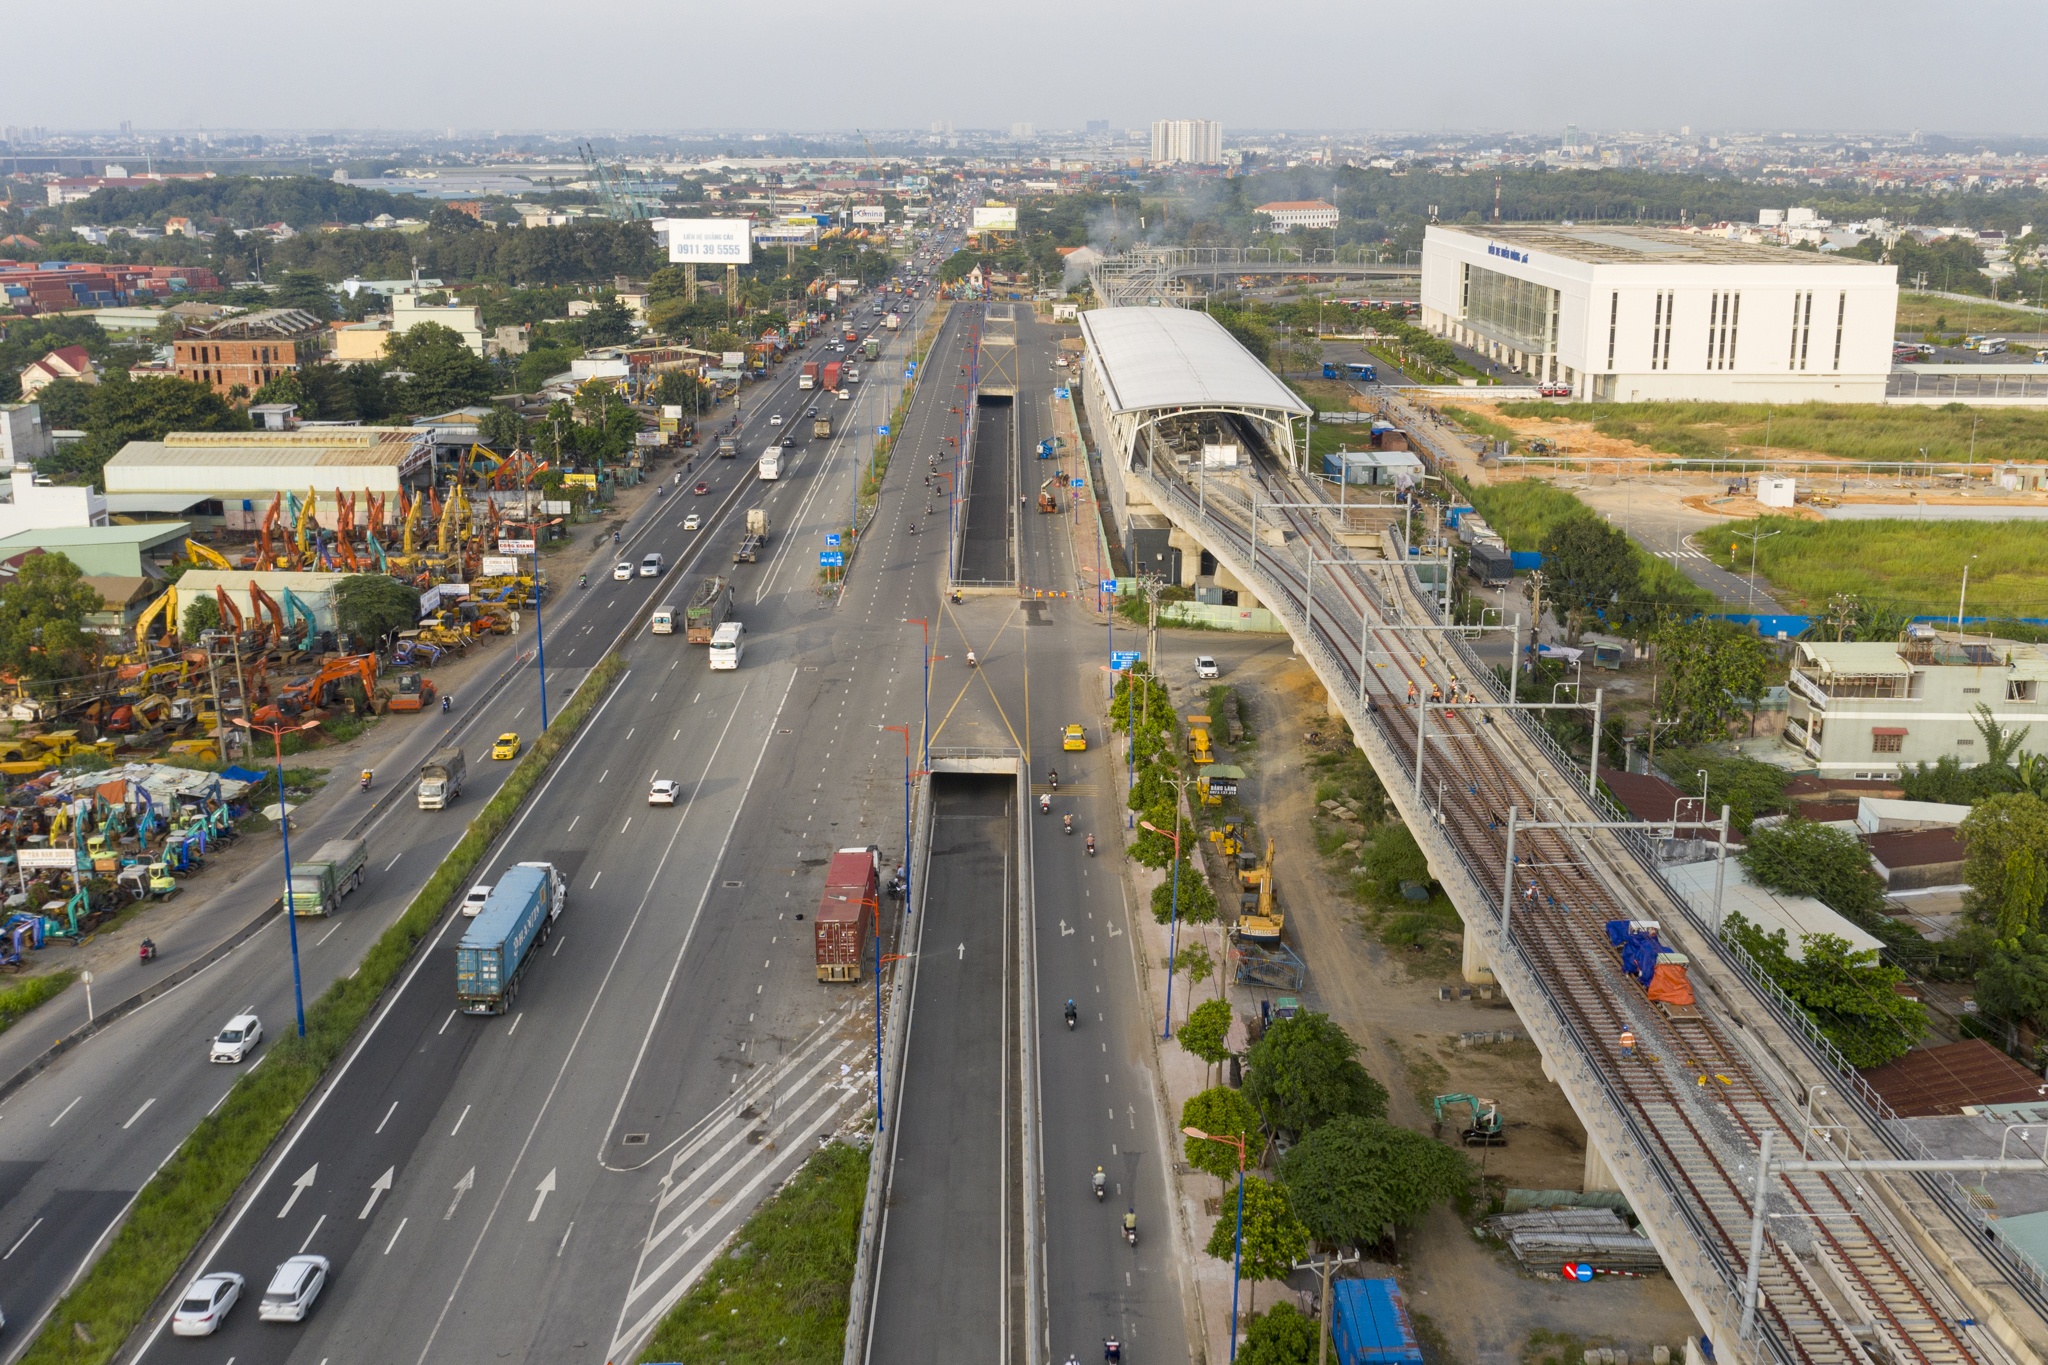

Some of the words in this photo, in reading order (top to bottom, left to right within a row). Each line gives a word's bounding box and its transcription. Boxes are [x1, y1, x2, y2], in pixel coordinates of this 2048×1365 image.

[854, 209, 883, 217] Pomina
[683, 232, 695, 240] LIÊN
[704, 232, 722, 241] QUẢNG
[723, 233, 734, 241] CÁO
[677, 244, 699, 254] 0911
[703, 244, 714, 255] 39
[717, 244, 740, 255] 5555
[518, 904, 540, 946] HANJIN
